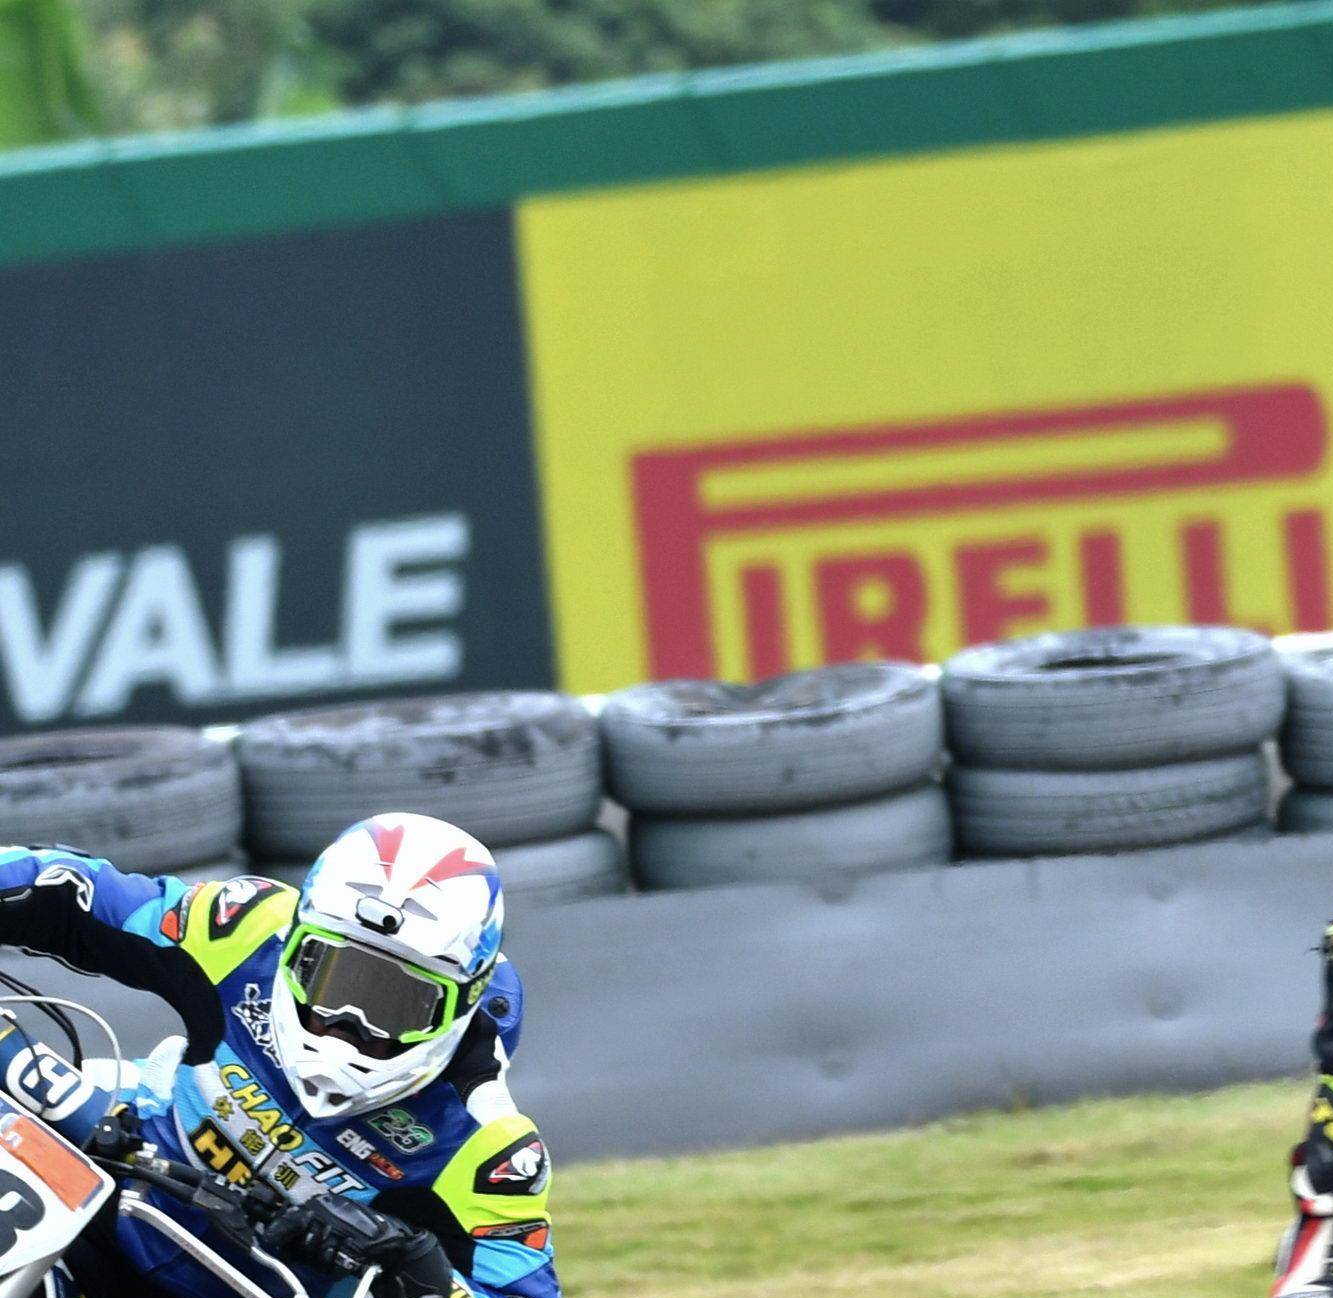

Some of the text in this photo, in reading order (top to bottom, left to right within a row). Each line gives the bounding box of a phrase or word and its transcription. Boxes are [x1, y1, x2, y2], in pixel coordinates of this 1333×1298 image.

[0, 510, 471, 723] VALE
[219, 1063, 368, 1196] CHAO FIT
[336, 1128, 376, 1161] ENG
